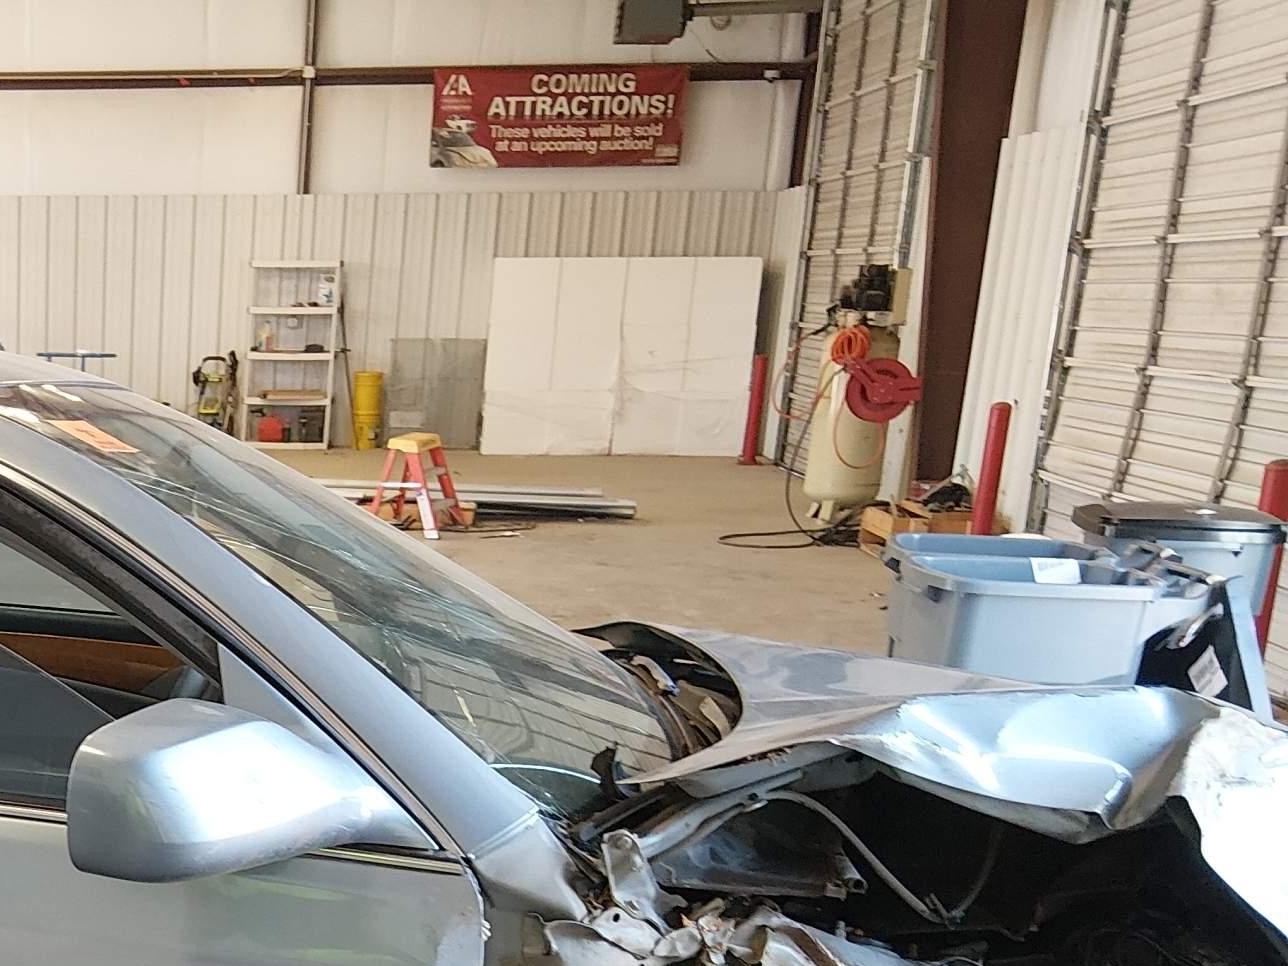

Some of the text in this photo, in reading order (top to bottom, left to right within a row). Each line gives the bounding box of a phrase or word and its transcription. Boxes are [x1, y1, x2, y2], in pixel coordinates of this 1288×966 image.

[531, 73, 637, 94] COMING
[487, 95, 675, 117] ATTRACTIONS!
[488, 123, 663, 138] These vehicles will be sold
[494, 140, 509, 151] at
[510, 141, 528, 151] an
[530, 139, 598, 154] upcoming
[599, 138, 654, 150] auction!
